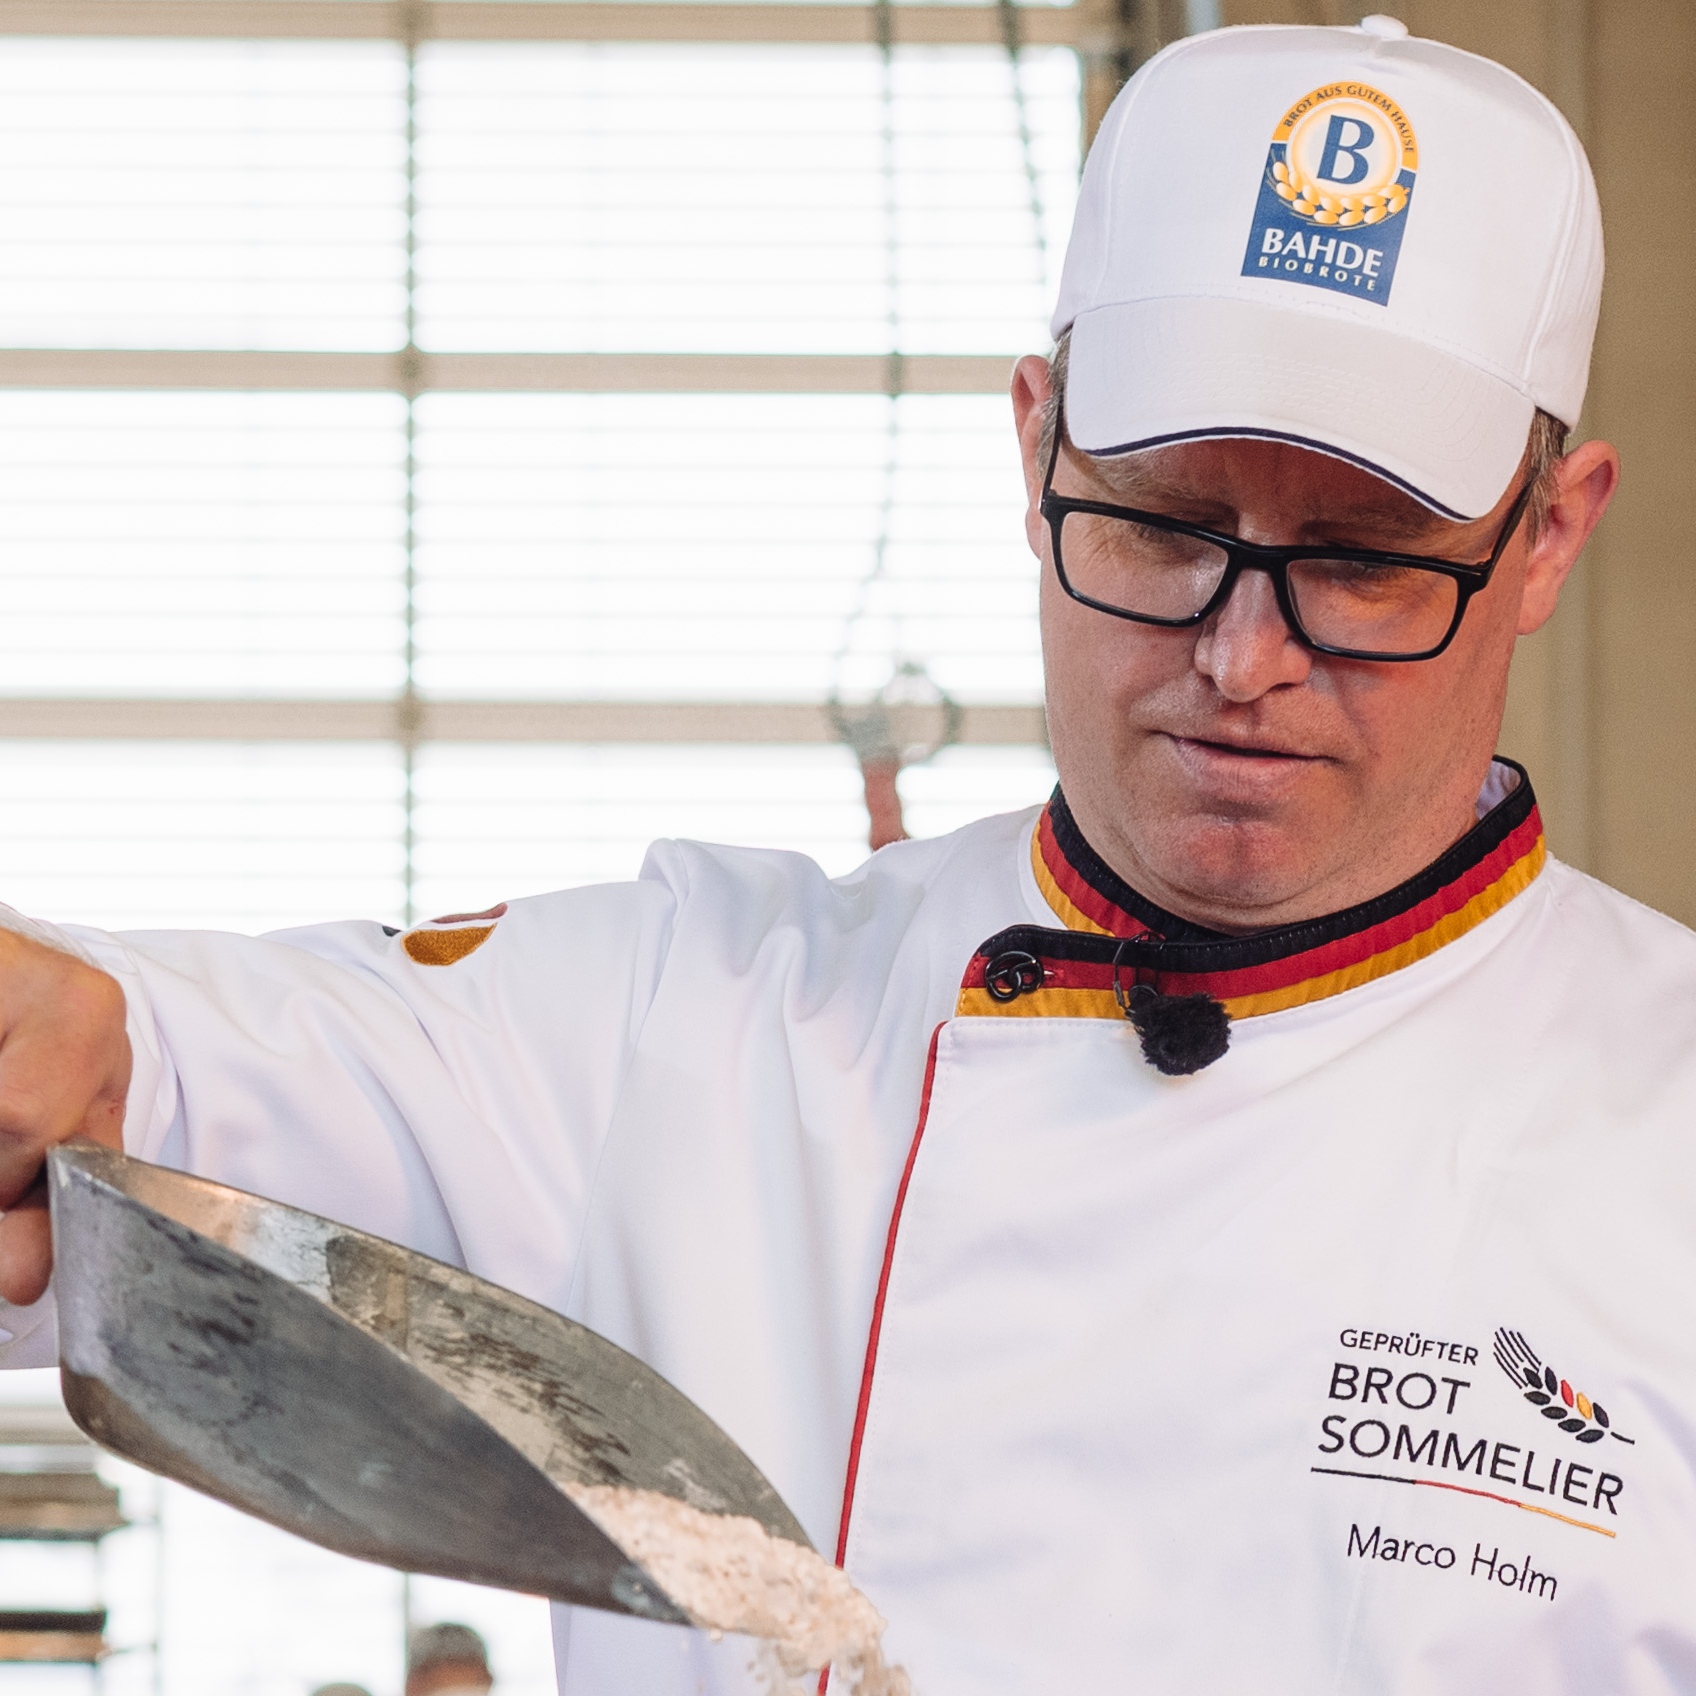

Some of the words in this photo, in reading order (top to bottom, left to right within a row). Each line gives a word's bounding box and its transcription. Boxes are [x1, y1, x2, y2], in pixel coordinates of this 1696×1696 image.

[1283, 98, 1313, 127] BROT
[1316, 85, 1342, 101] AUS
[1346, 85, 1392, 112] GUTEM
[1391, 110, 1415, 153] HAUSE
[1316, 114, 1375, 184] B
[1258, 255, 1376, 291] BIOBROTE
[1261, 227, 1384, 277] BAHDE
[1339, 1328, 1479, 1366] GEPRÜFTER
[1328, 1362, 1471, 1415] BROT
[1318, 1415, 1624, 1515] SOMMELIER
[1346, 1523, 1457, 1569] Marco
[1470, 1542, 1558, 1601] Holm
